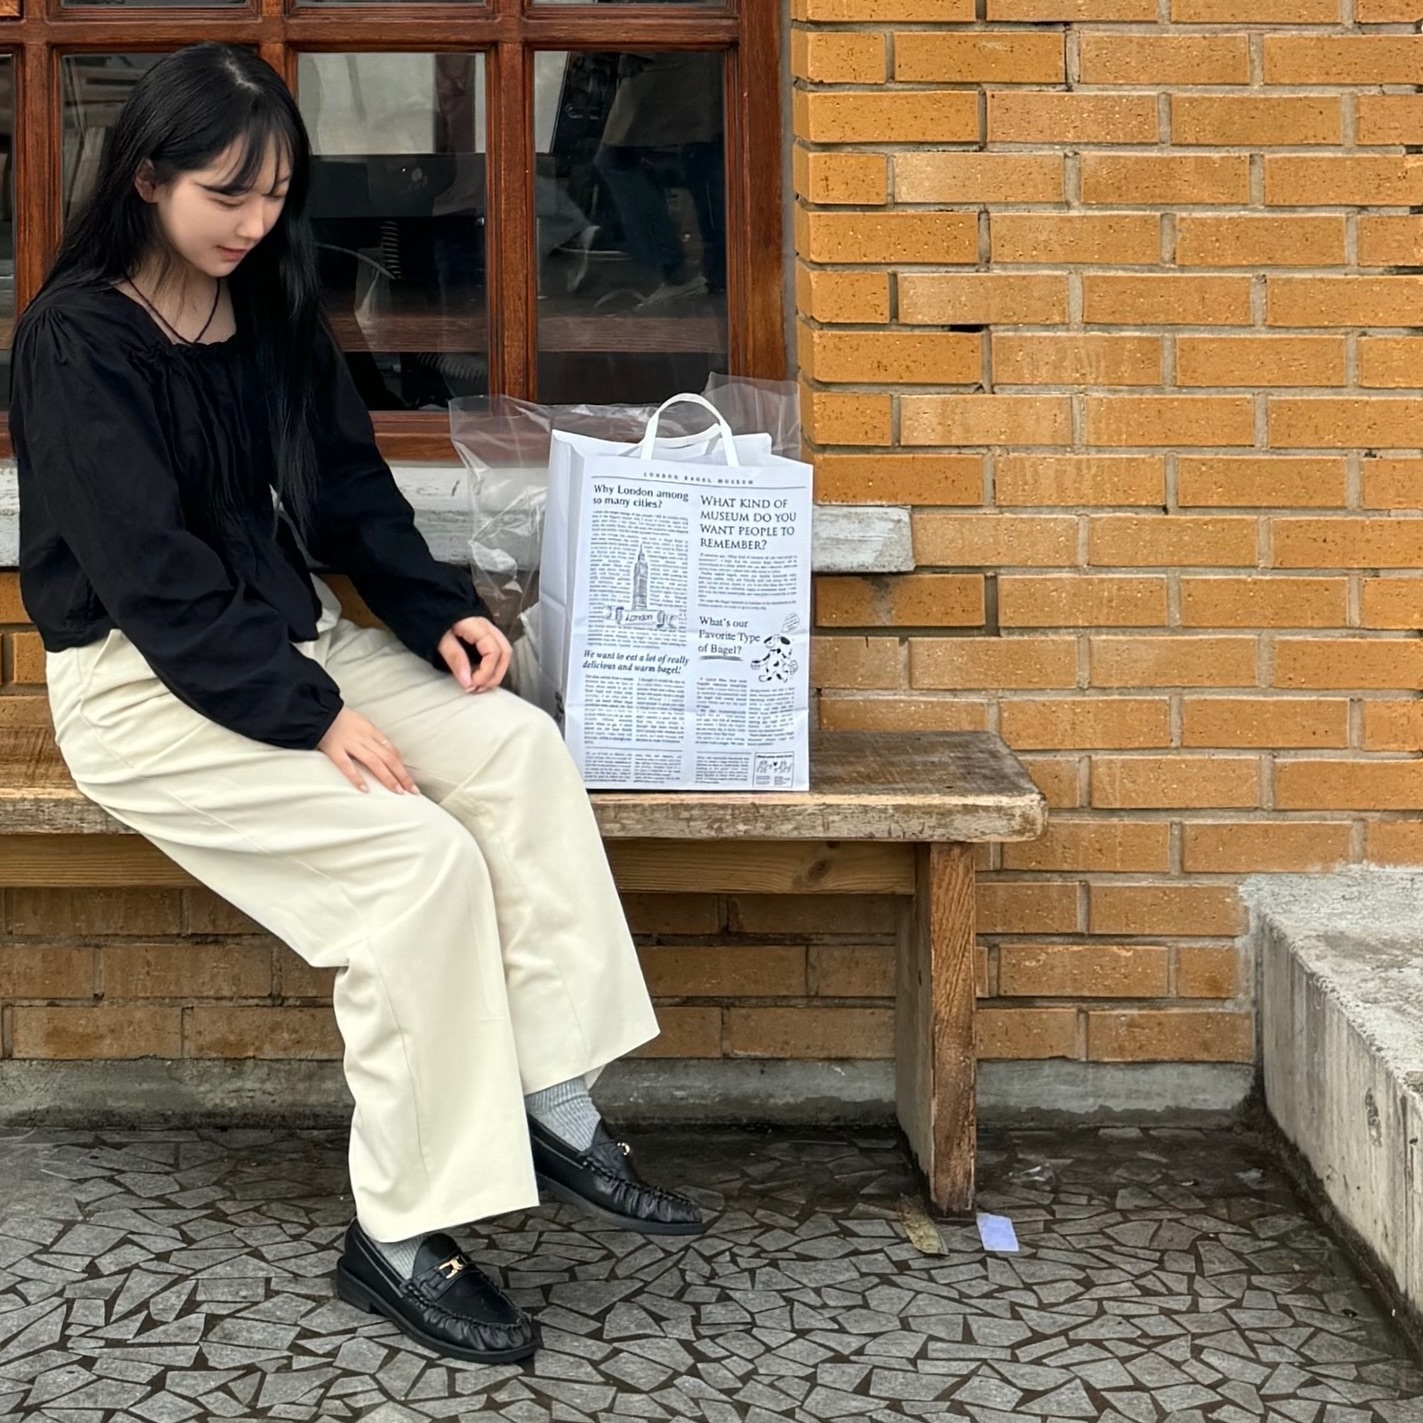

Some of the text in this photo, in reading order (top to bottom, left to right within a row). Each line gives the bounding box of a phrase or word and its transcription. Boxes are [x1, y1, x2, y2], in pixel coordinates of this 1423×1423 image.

[593, 483, 689, 502] Why London among
[592, 496, 663, 509] so many cities?
[739, 498, 771, 509] KIND
[773, 498, 789, 509] OF
[699, 510, 797, 523] MUSEUM DO YOU
[699, 523, 736, 536] WANT
[738, 525, 778, 537] PEOPLE
[780, 525, 796, 537] TO
[699, 537, 768, 551] REMEMBER?
[624, 613, 654, 622] London
[732, 620, 749, 628] our
[698, 629, 736, 641] Favorite
[737, 631, 761, 645] Type
[697, 643, 743, 656] of Bagel?
[584, 649, 596, 659] We
[596, 652, 616, 660] want
[616, 652, 625, 661] to
[625, 653, 639, 662] eat
[645, 653, 657, 663] lot
[657, 654, 668, 666] of
[667, 655, 690, 667] really
[582, 660, 683, 676] delicious and warm bagel!
